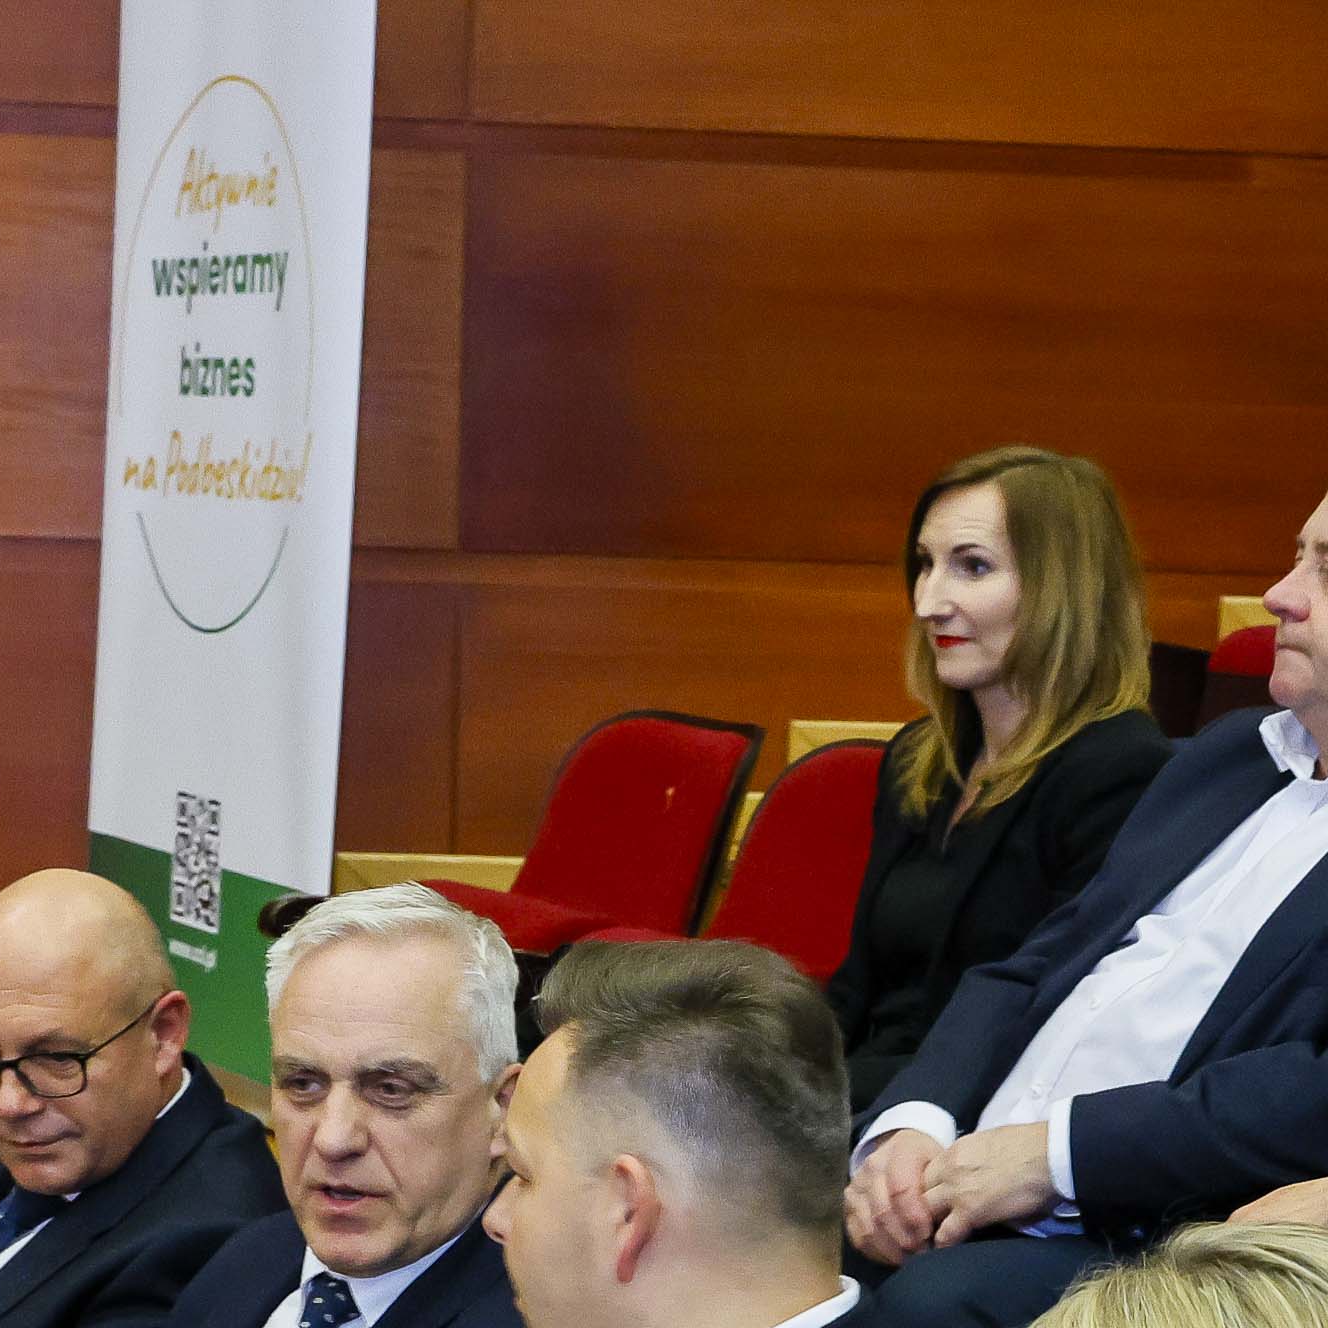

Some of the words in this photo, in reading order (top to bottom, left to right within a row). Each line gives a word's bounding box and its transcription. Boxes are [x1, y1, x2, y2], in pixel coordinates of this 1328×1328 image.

[175, 147, 278, 233] Aktywnie
[152, 240, 289, 313] wspieramy
[179, 341, 256, 397] biznes
[123, 456, 157, 490] na
